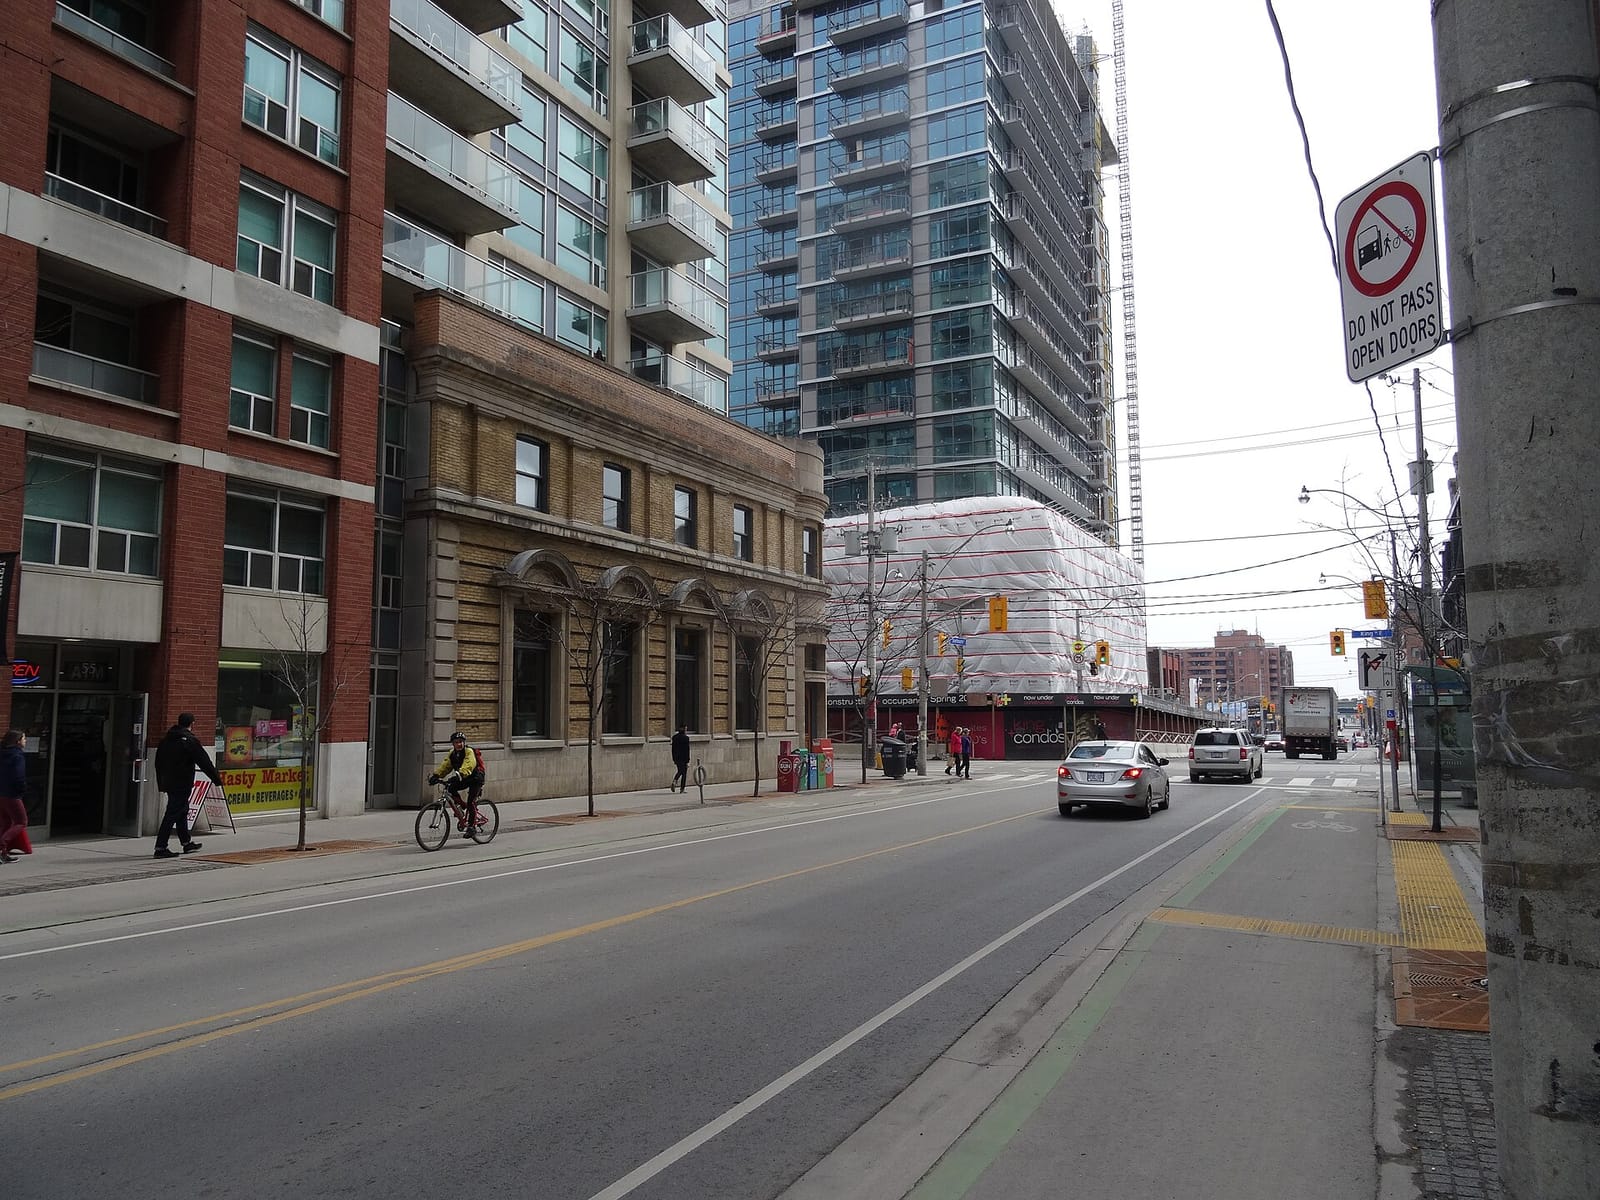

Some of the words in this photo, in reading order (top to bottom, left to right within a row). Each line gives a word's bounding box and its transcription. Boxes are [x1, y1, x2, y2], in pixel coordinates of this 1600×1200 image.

[1349, 315, 1365, 341] DO
[1371, 300, 1395, 331] NOT
[1401, 282, 1434, 317] PASS
[1352, 336, 1384, 370] OPEN
[1390, 314, 1436, 354] DOORS
[11, 664, 40, 677] PEN
[930, 694, 957, 704] Spring
[1013, 728, 1064, 744] condos
[187, 780, 210, 805] TM
[228, 791, 251, 805] CREAM
[255, 789, 294, 803] BEVERAGES
